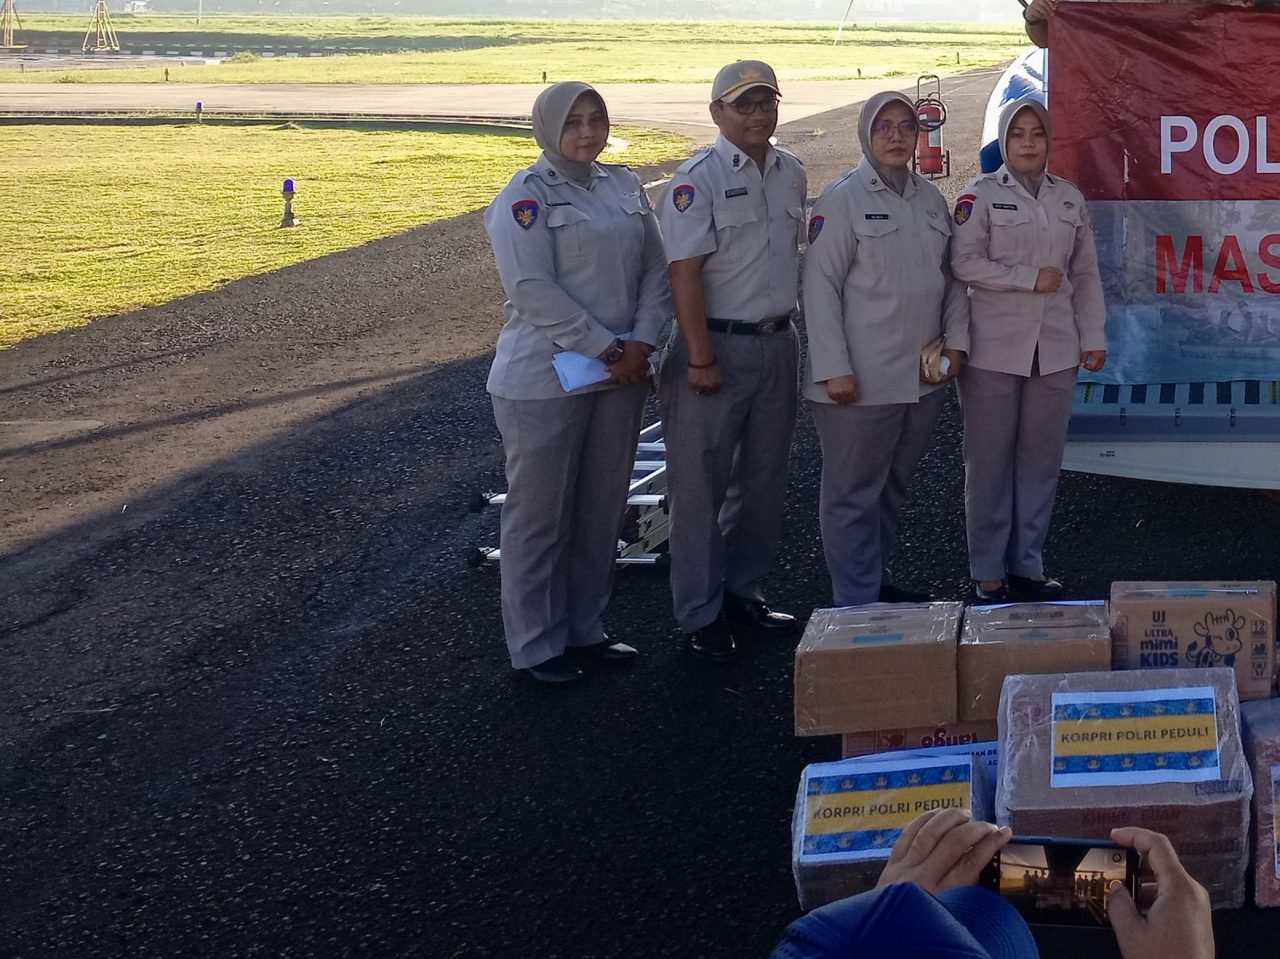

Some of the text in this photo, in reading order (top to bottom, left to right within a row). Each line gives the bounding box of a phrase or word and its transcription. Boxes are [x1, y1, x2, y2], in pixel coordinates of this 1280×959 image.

[1144, 628, 1173, 638] ULTRA
[1140, 637, 1179, 651] mimi
[1140, 652, 1179, 667] KIDS
[1061, 726, 1209, 744] KORPRI POLRI PEDULI
[813, 797, 963, 820] KORPRI POLRI PEDULI
